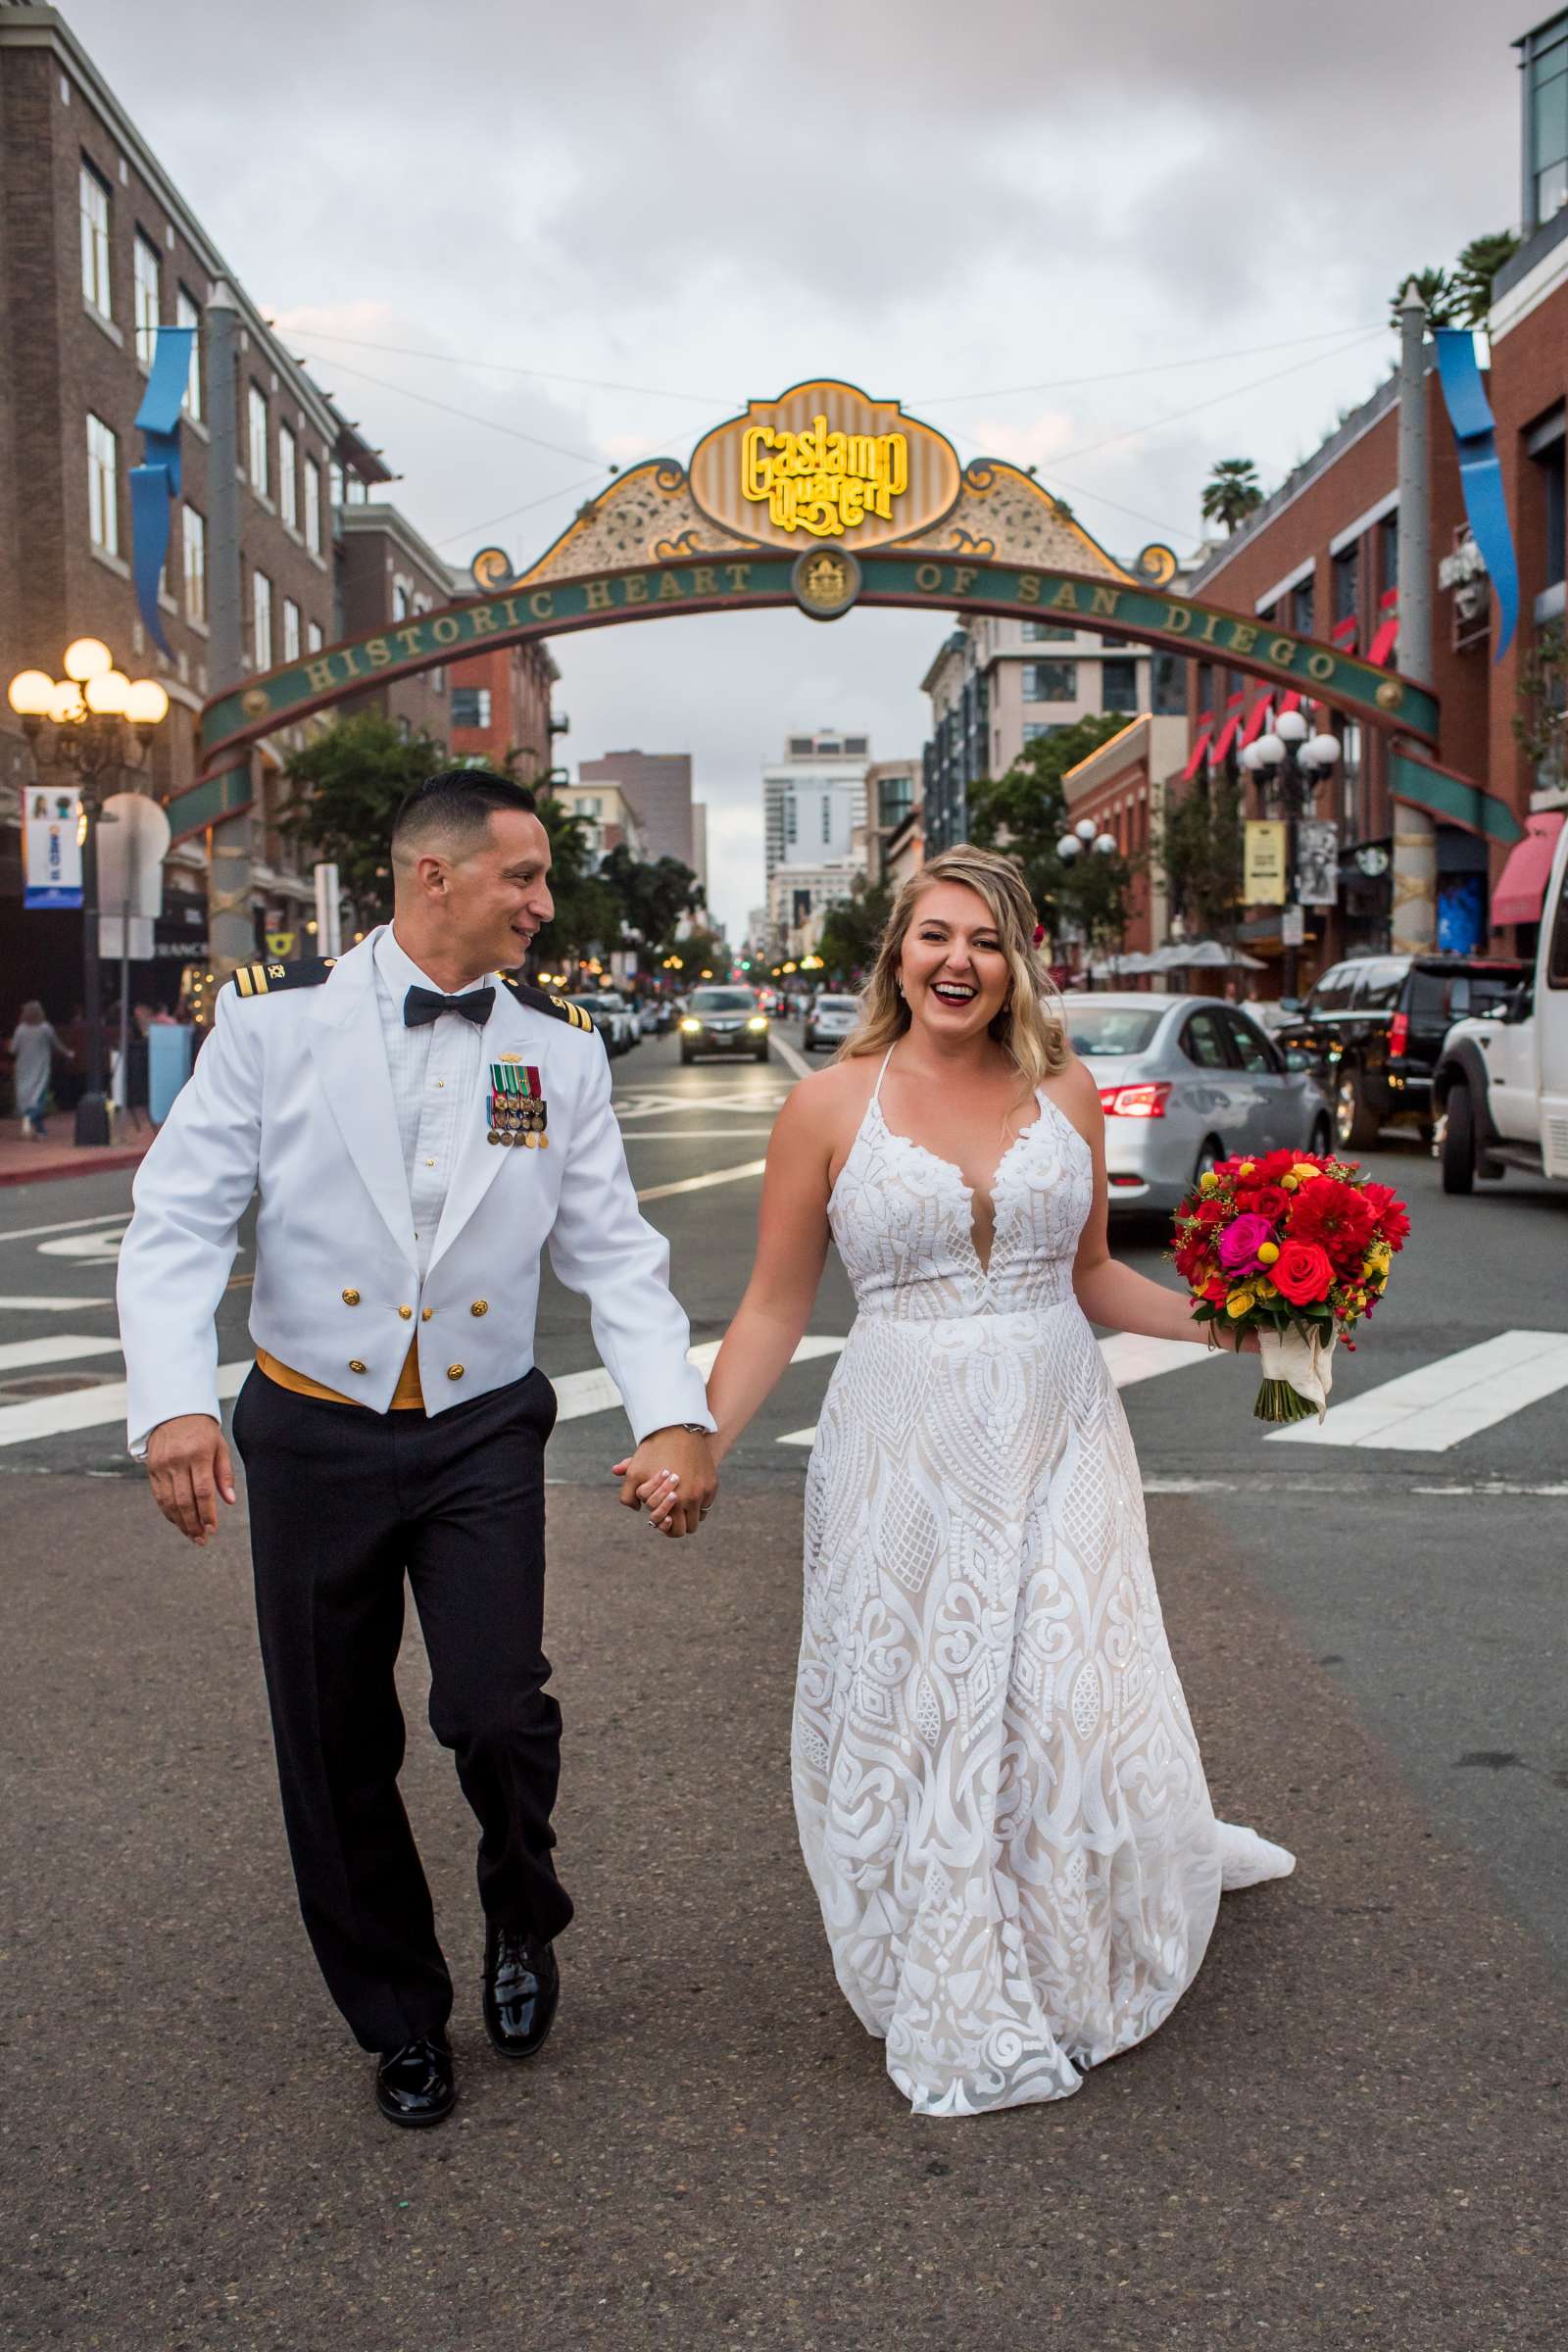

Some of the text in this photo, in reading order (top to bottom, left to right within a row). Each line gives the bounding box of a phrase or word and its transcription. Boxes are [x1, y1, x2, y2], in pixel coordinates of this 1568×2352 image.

[742, 415, 907, 519] Gaslamp
[303, 563, 1336, 692] HISTORIC HEART OF SAN DIEGO
